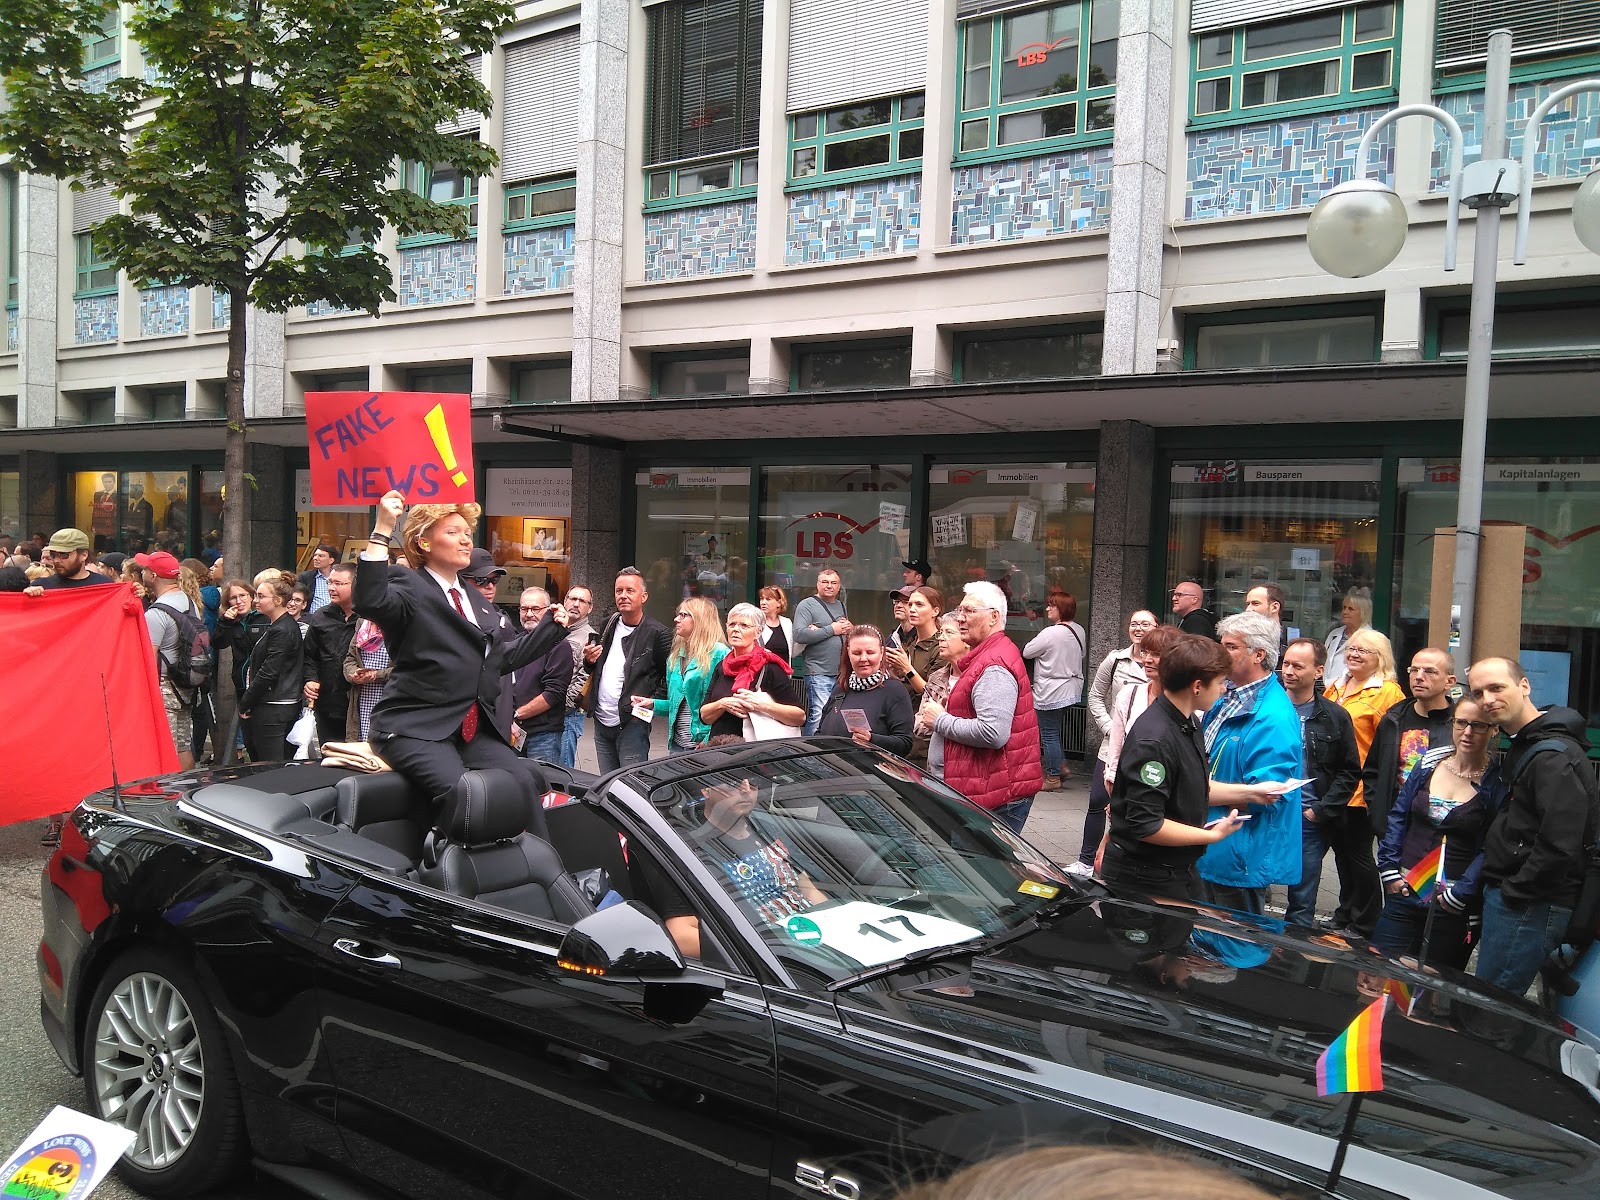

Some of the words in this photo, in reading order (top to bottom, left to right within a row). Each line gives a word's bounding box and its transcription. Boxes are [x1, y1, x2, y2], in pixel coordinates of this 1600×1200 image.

[1017, 50, 1047, 67] LBS
[314, 394, 394, 460] FAKE
[337, 463, 439, 498] NEWS
[503, 477, 541, 485] Rheinhäuser
[686, 475, 717, 483] Immobilien
[998, 473, 1039, 481] Immobilien
[1256, 471, 1303, 480] Bausparen
[1431, 471, 1460, 482] LBS
[1500, 469, 1581, 481] Kapitalanlagen
[796, 531, 854, 559] LBS
[857, 915, 926, 943] 17
[43, 1136, 75, 1150] LOVE
[73, 1136, 93, 1157] WINS
[795, 1162, 860, 1200] 5.0
